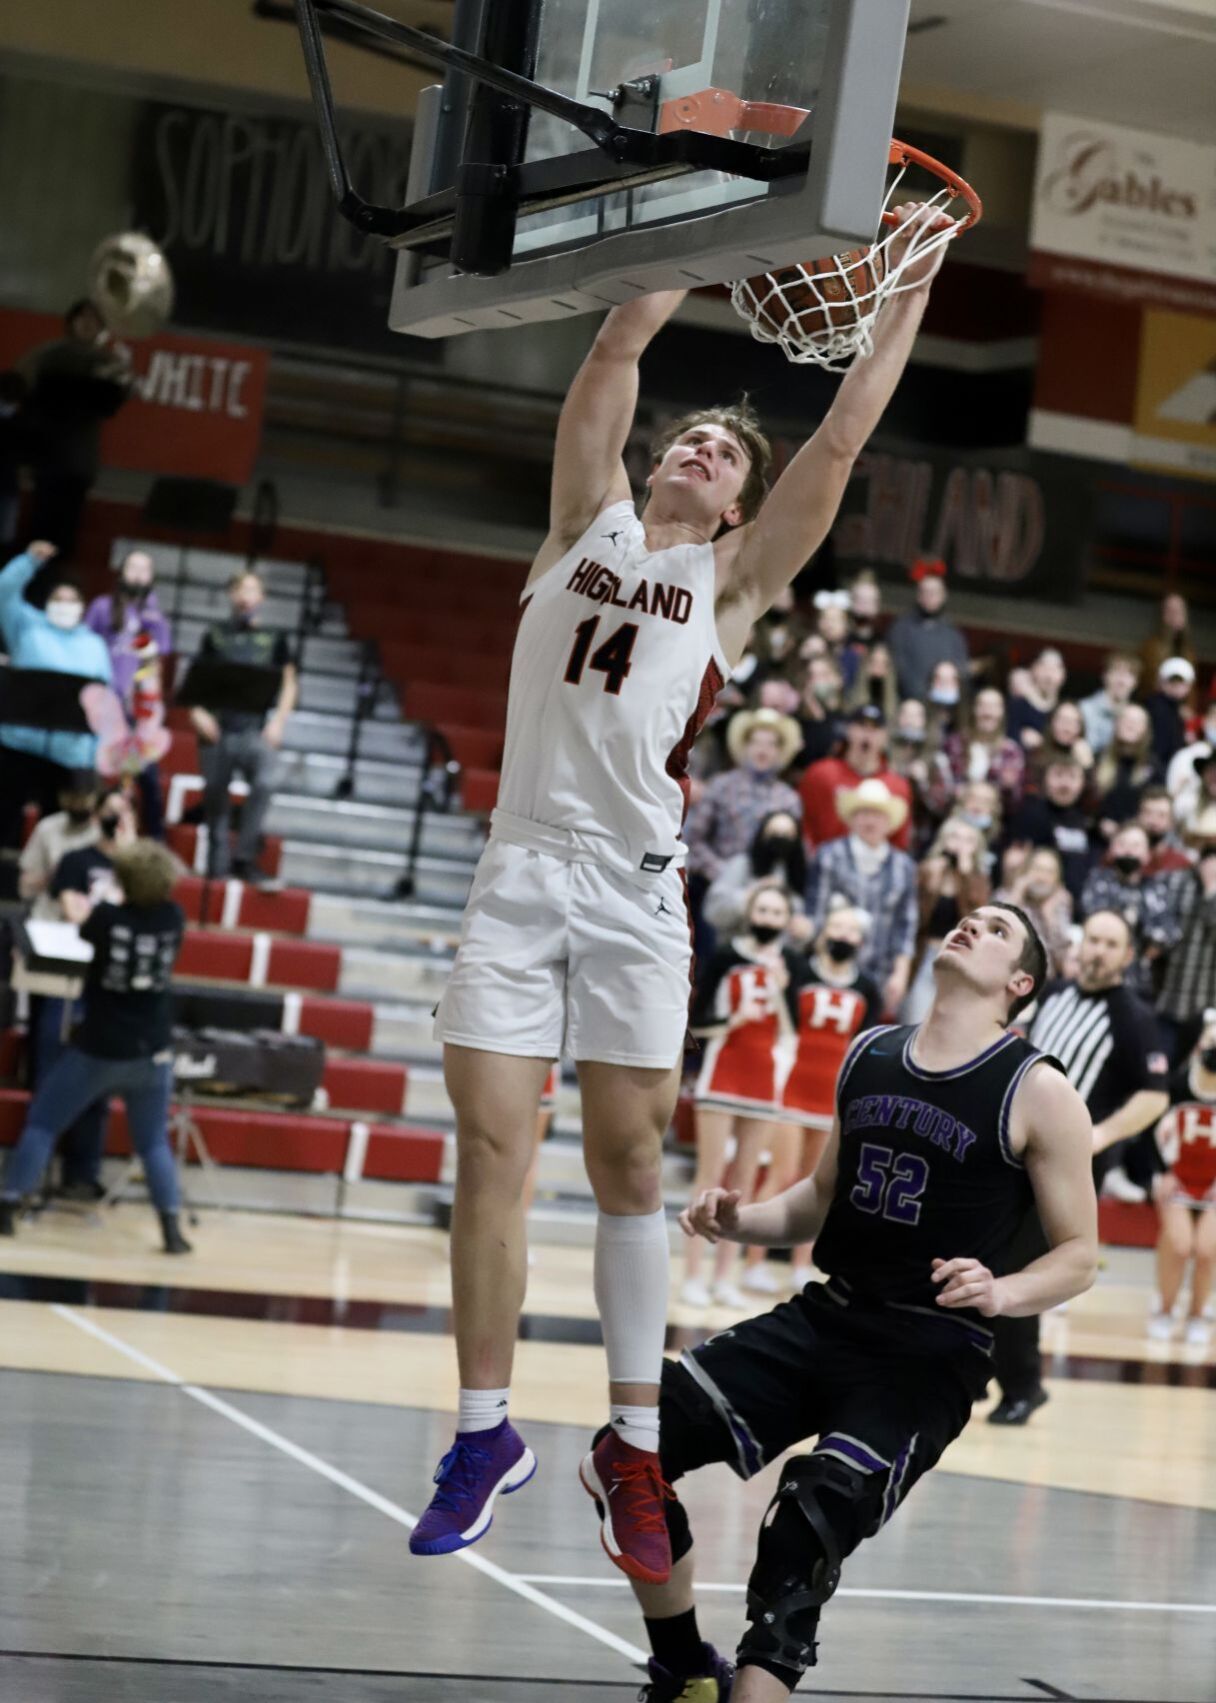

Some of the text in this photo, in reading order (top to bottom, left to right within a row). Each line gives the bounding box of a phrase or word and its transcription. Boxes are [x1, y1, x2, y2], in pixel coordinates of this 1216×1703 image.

[563, 614, 640, 696] 14
[810, 988, 857, 1034] H
[843, 1094, 977, 1164] CENTURY
[850, 1142, 930, 1226] 52
